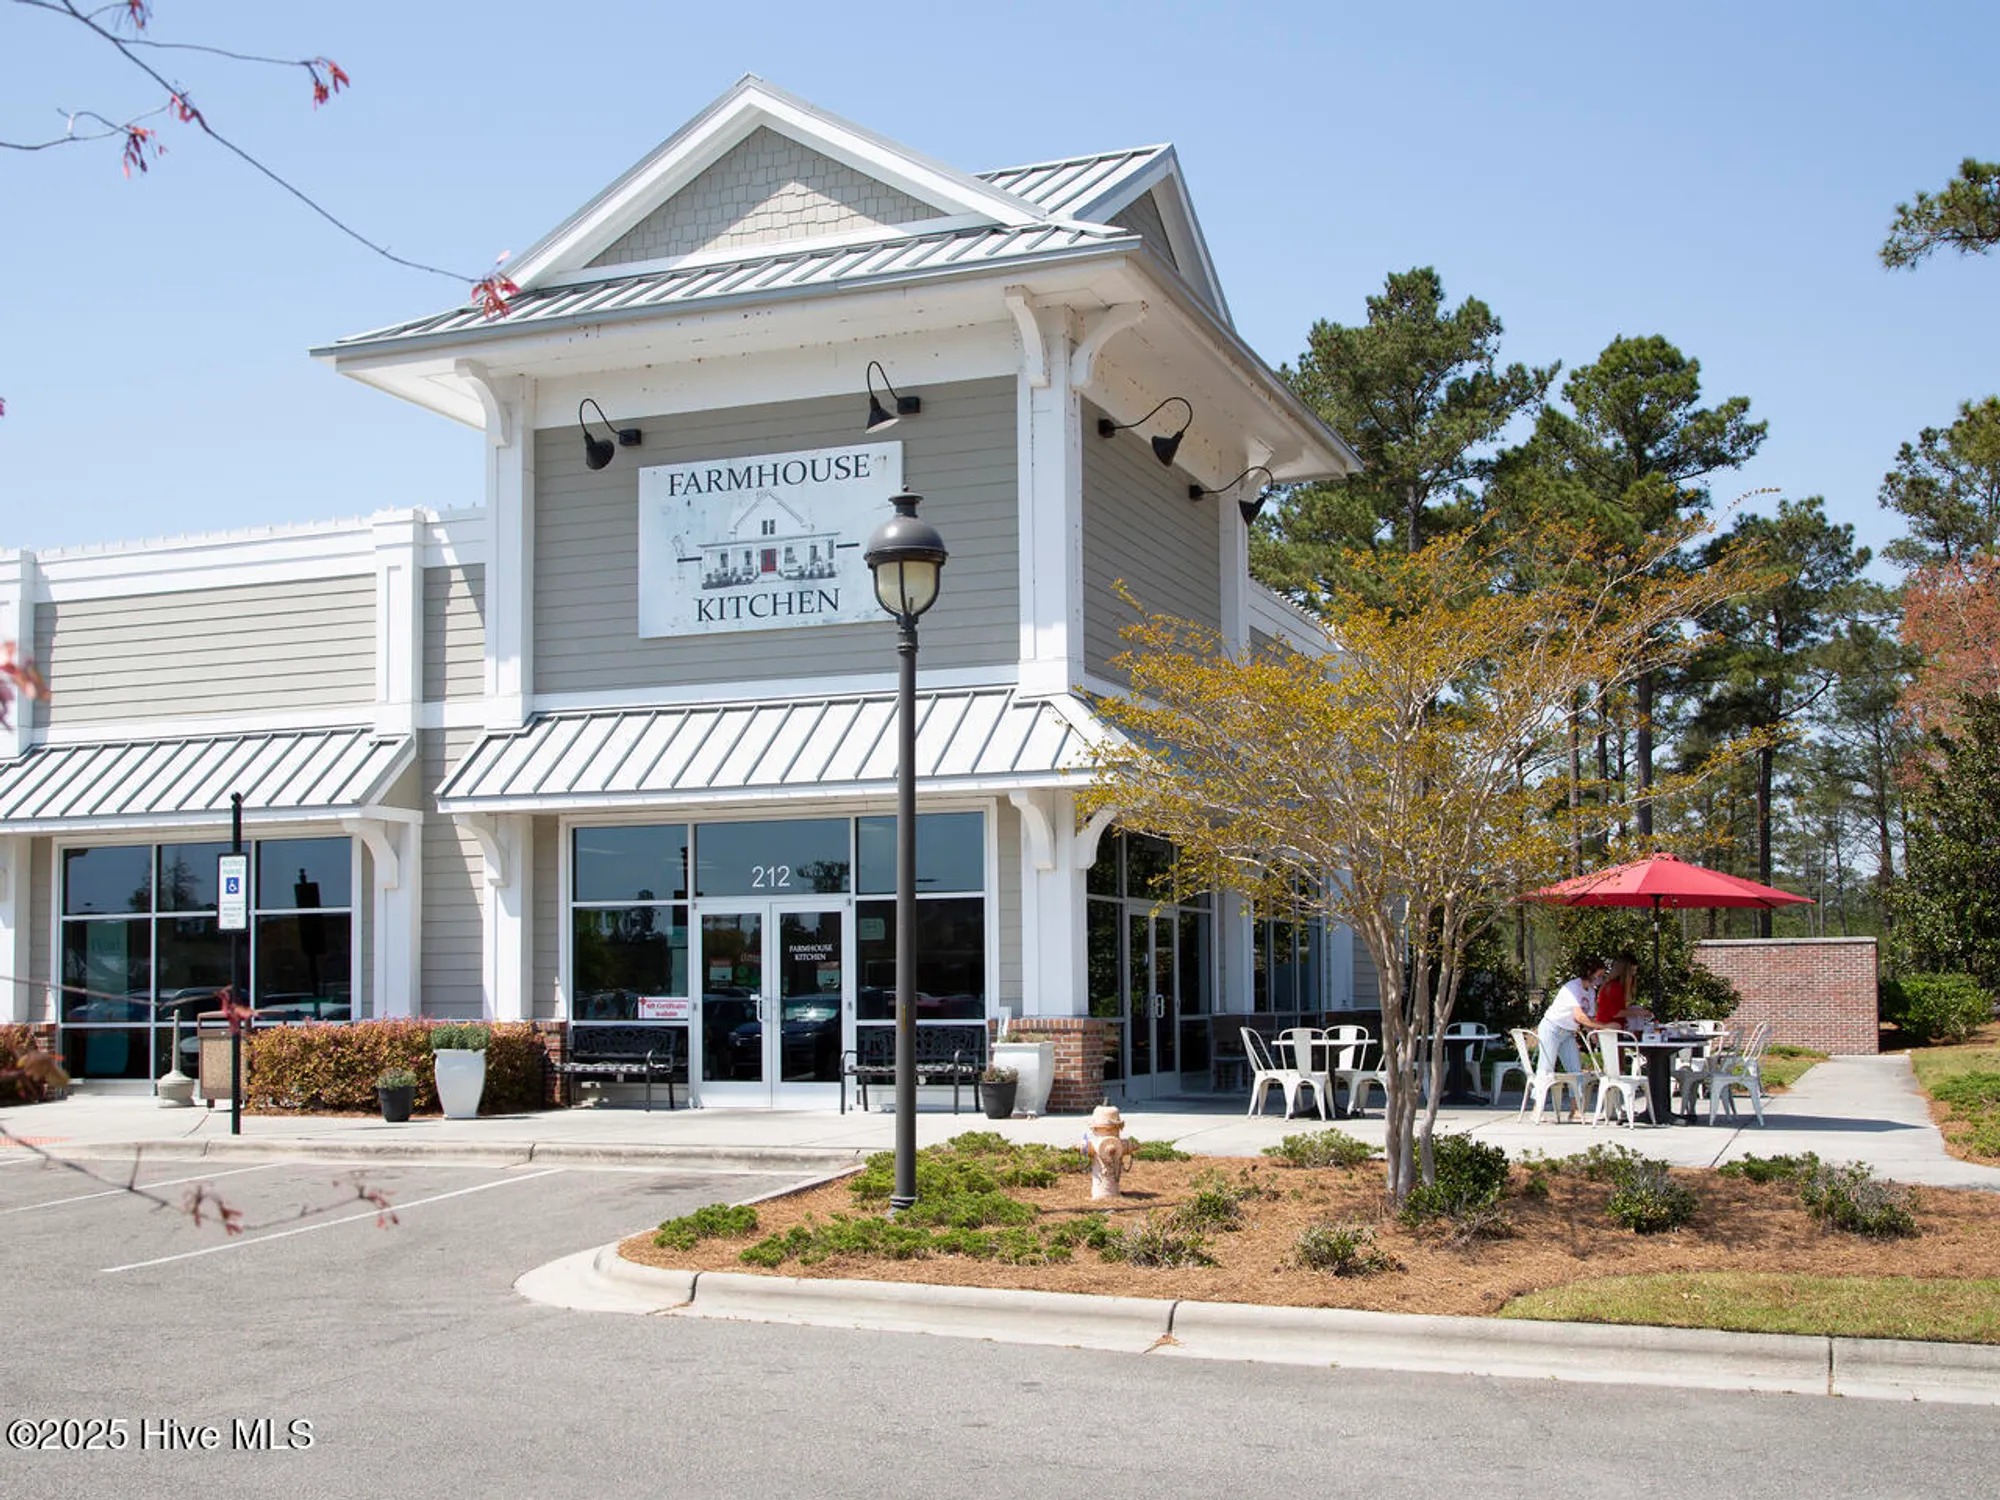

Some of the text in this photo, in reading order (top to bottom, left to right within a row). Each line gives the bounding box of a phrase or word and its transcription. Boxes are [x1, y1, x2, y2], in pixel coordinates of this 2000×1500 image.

[668, 453, 871, 497] FARMHOUSE
[695, 587, 841, 622] KITCHEN
[752, 865, 791, 888] 212
[789, 944, 834, 953] FARMHOUSE
[795, 953, 826, 961] KITCHEN
